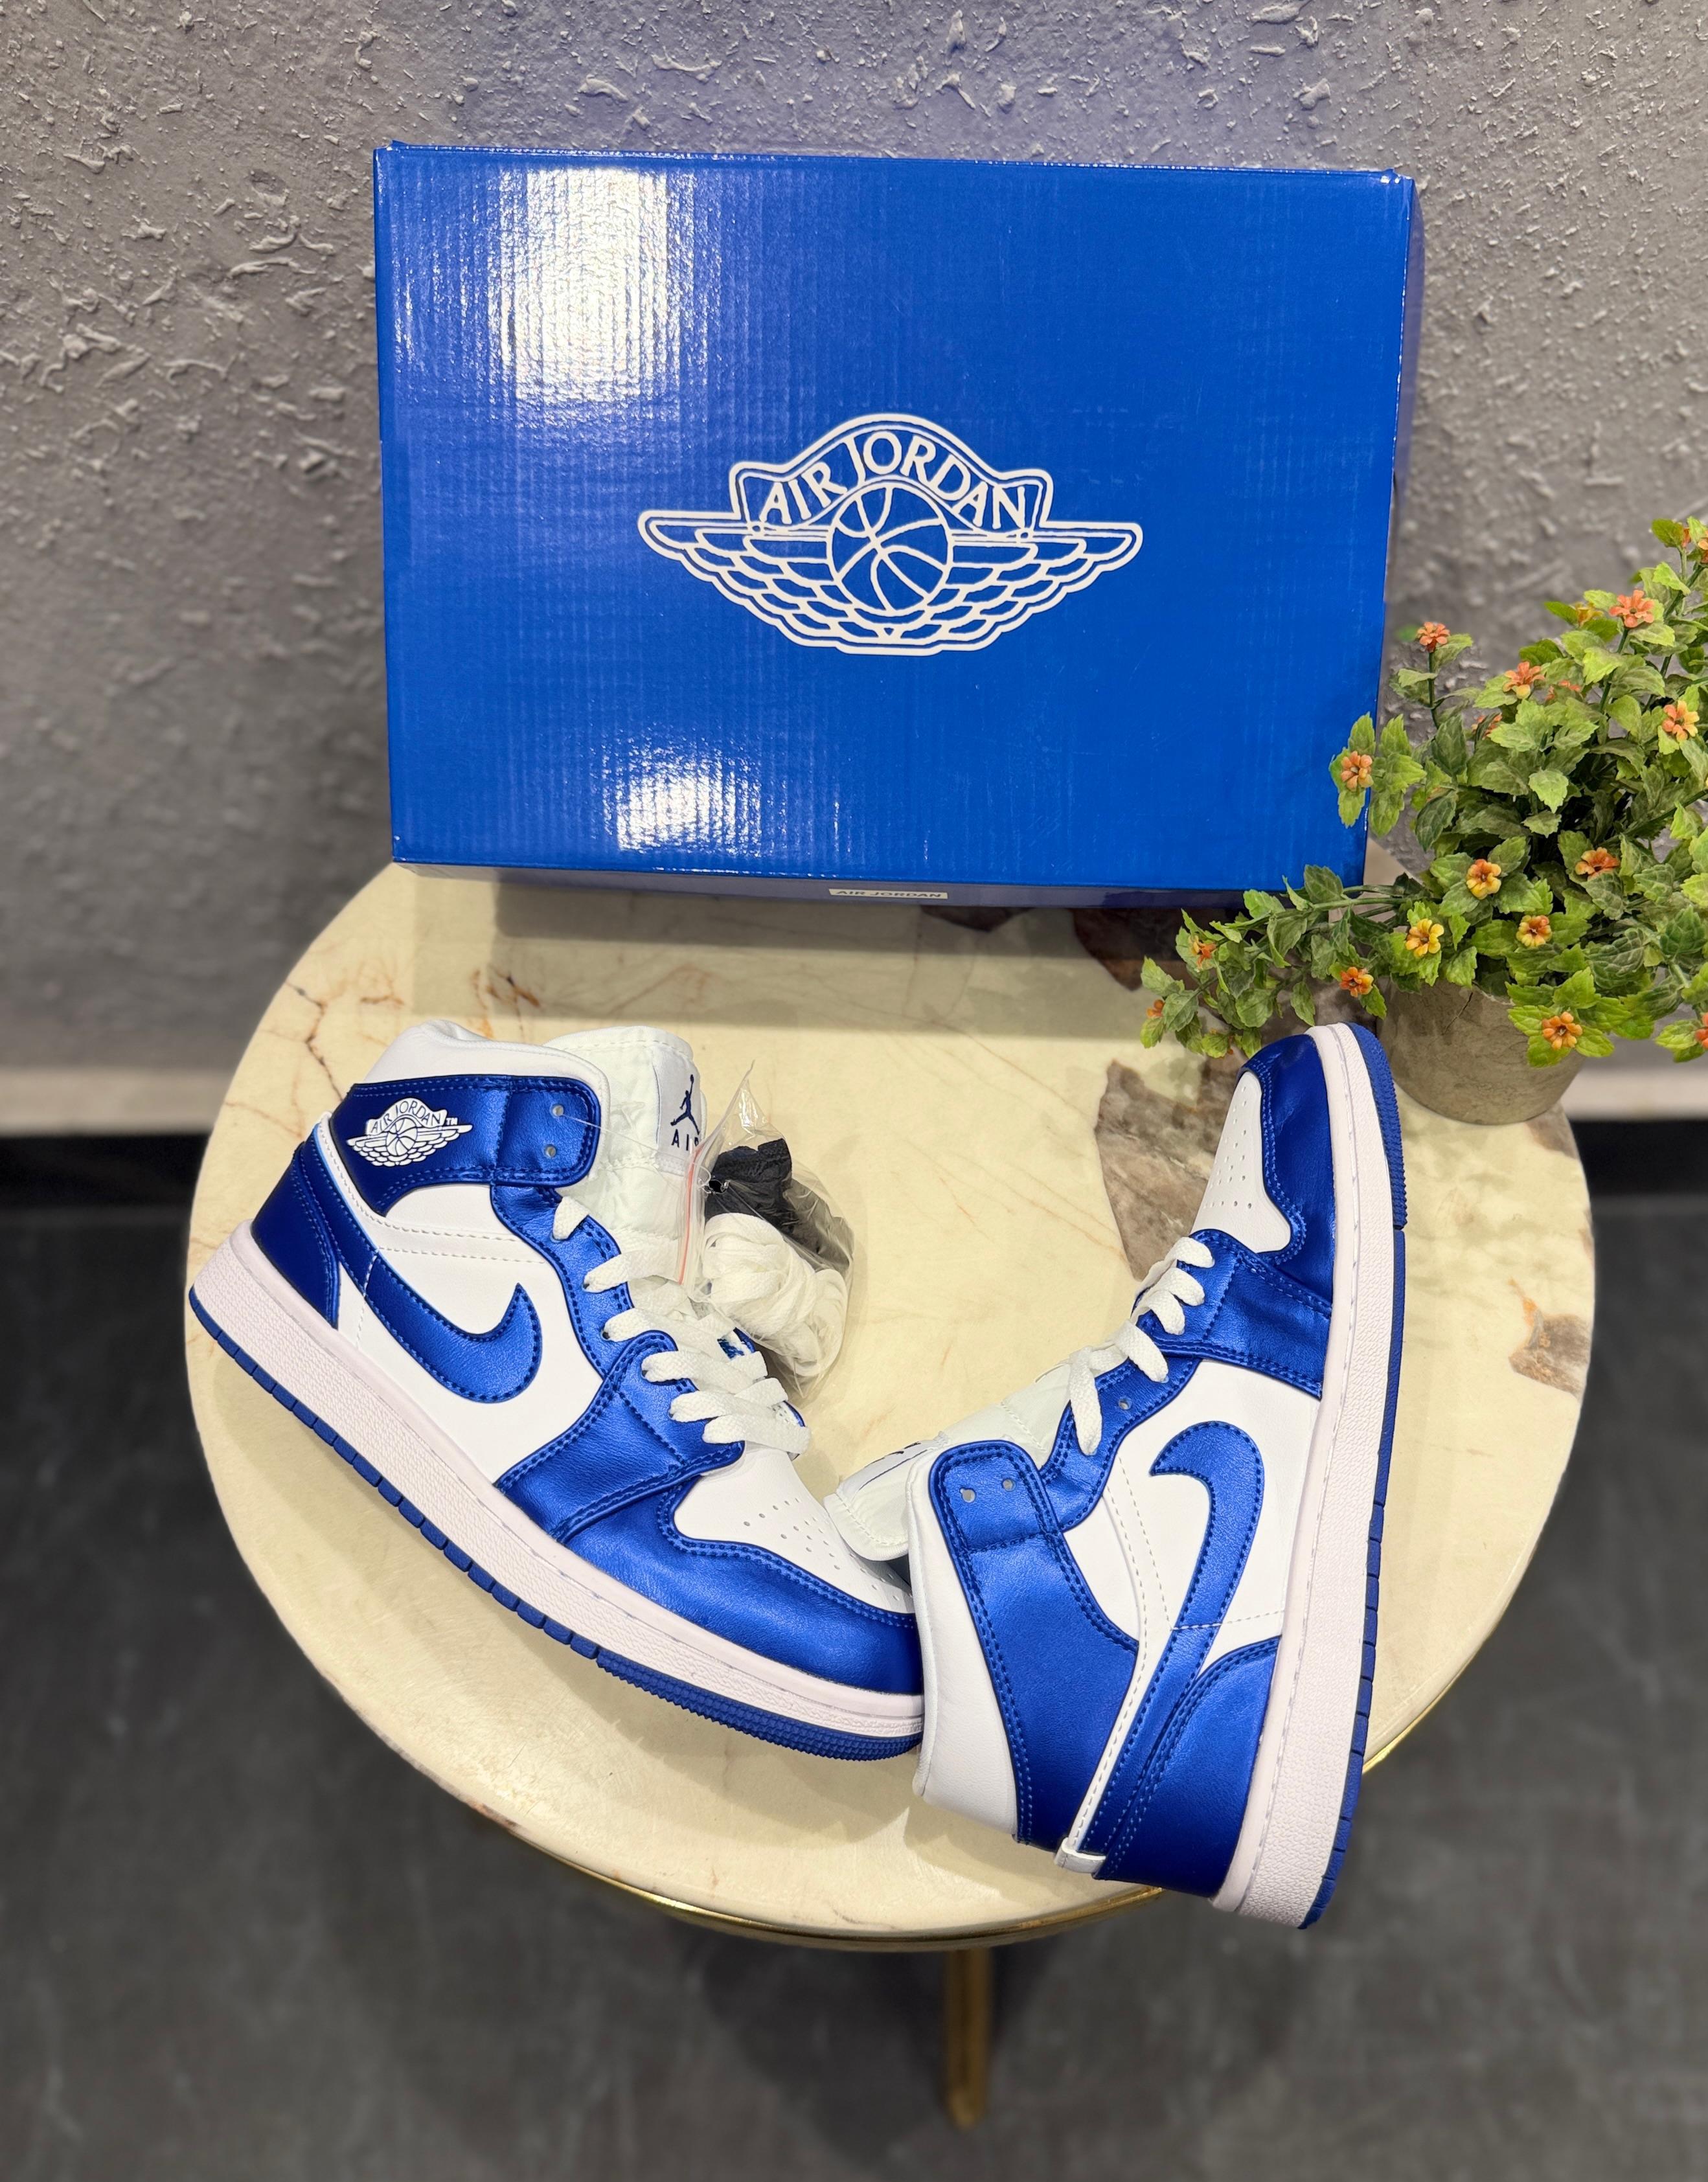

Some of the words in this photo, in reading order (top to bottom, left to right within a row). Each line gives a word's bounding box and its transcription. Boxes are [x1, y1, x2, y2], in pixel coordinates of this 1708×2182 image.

[760, 462, 846, 525] AIR
[843, 431, 1027, 529] JORDAN
[370, 1113, 393, 1133] AIR
